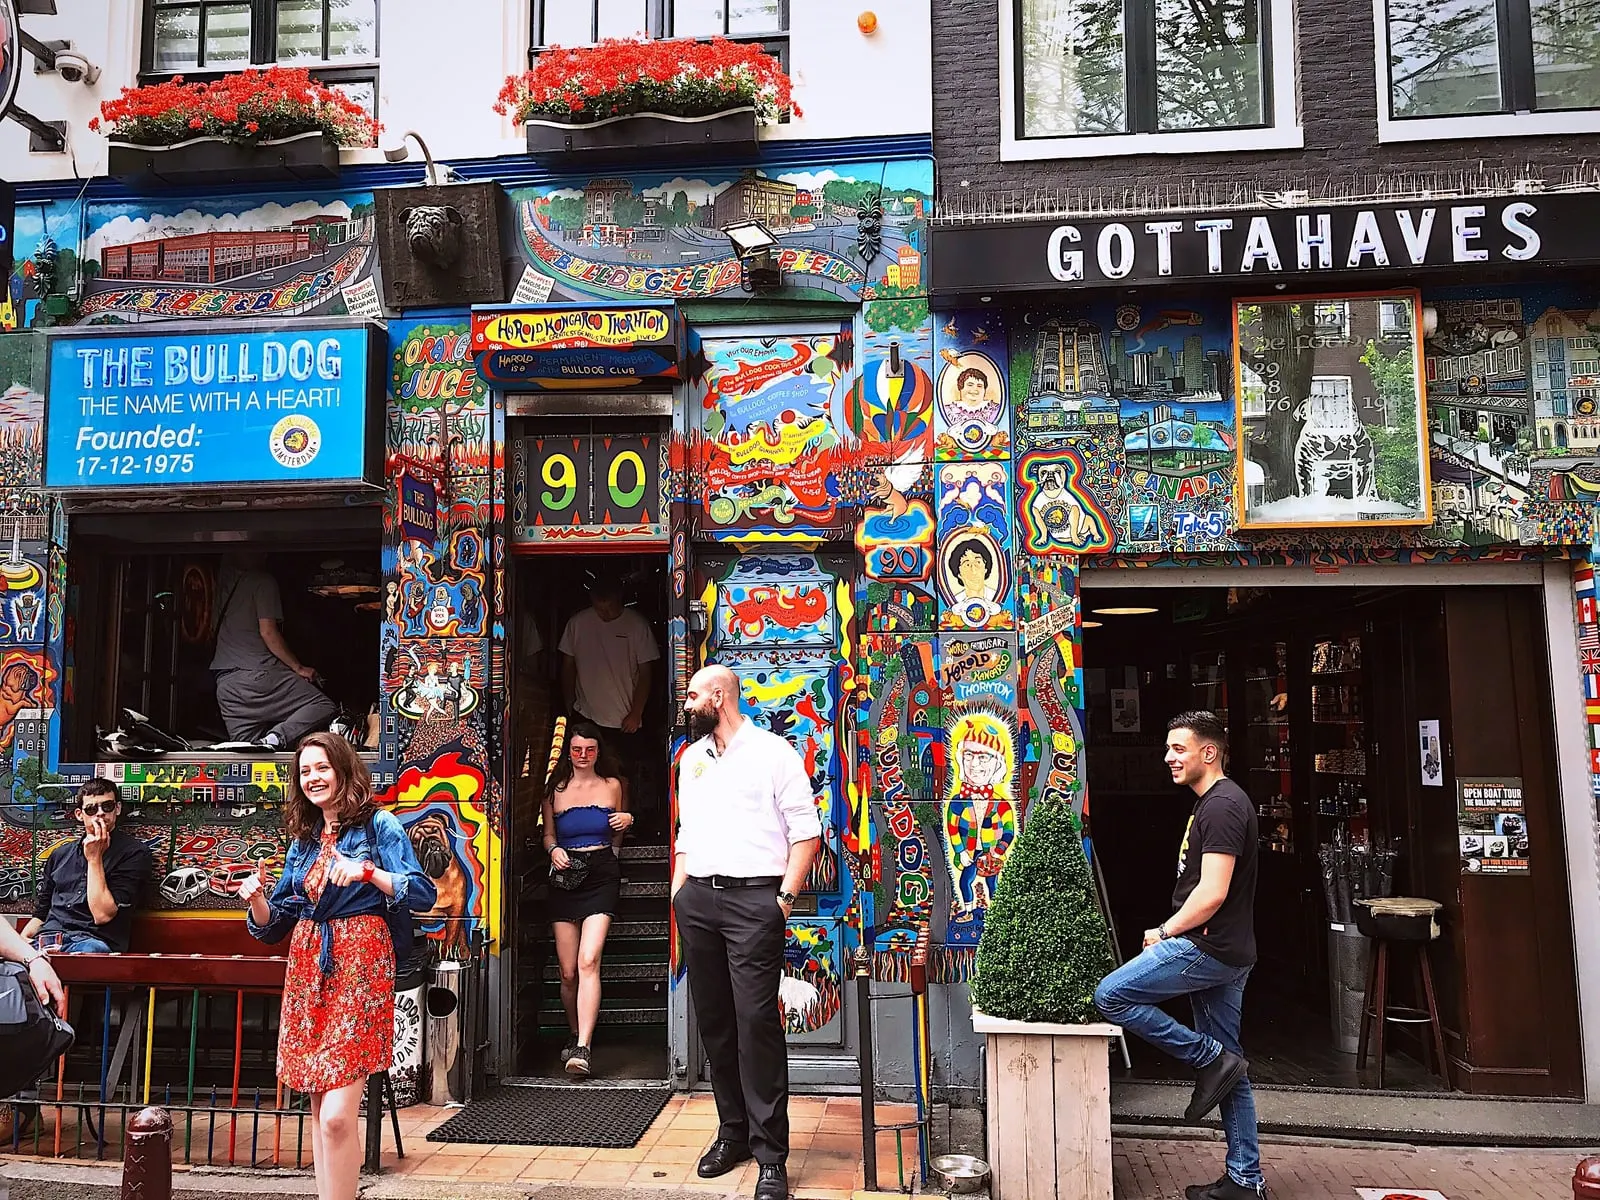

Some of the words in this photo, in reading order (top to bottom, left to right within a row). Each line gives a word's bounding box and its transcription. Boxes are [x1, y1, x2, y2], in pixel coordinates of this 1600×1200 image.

[1047, 203, 1542, 282] GOTTAHAVES
[554, 255, 664, 290] BULLDOG
[170, 293, 236, 312] BEST
[251, 263, 345, 310] BIGGEST
[77, 346, 153, 388] THE
[164, 338, 343, 387] BULLDOG
[561, 366, 605, 374] BULLDOG
[609, 366, 636, 374] CLUB
[401, 368, 477, 399] JUICE
[791, 389, 809, 398] SHOP
[79, 396, 117, 417] THE
[124, 393, 184, 415] NAME
[189, 391, 241, 412] WITH
[245, 390, 261, 411] A
[265, 387, 341, 409] HEART!
[75, 423, 202, 450] Founded:
[76, 454, 194, 475] 17-12-1975
[273, 446, 317, 466] AMSTERDAM
[540, 450, 646, 511] 90
[1134, 471, 1224, 501] CANADA
[413, 490, 425, 506] THE
[403, 504, 434, 530] BULLDOG
[879, 546, 918, 574] 90
[946, 642, 969, 655] WORLD
[959, 681, 1012, 699] THORNTON
[1464, 788, 1482, 798] OPEN
[1484, 788, 1501, 798] BOAT
[1503, 788, 1522, 798] TOUR
[879, 726, 928, 906] BULLDOG
